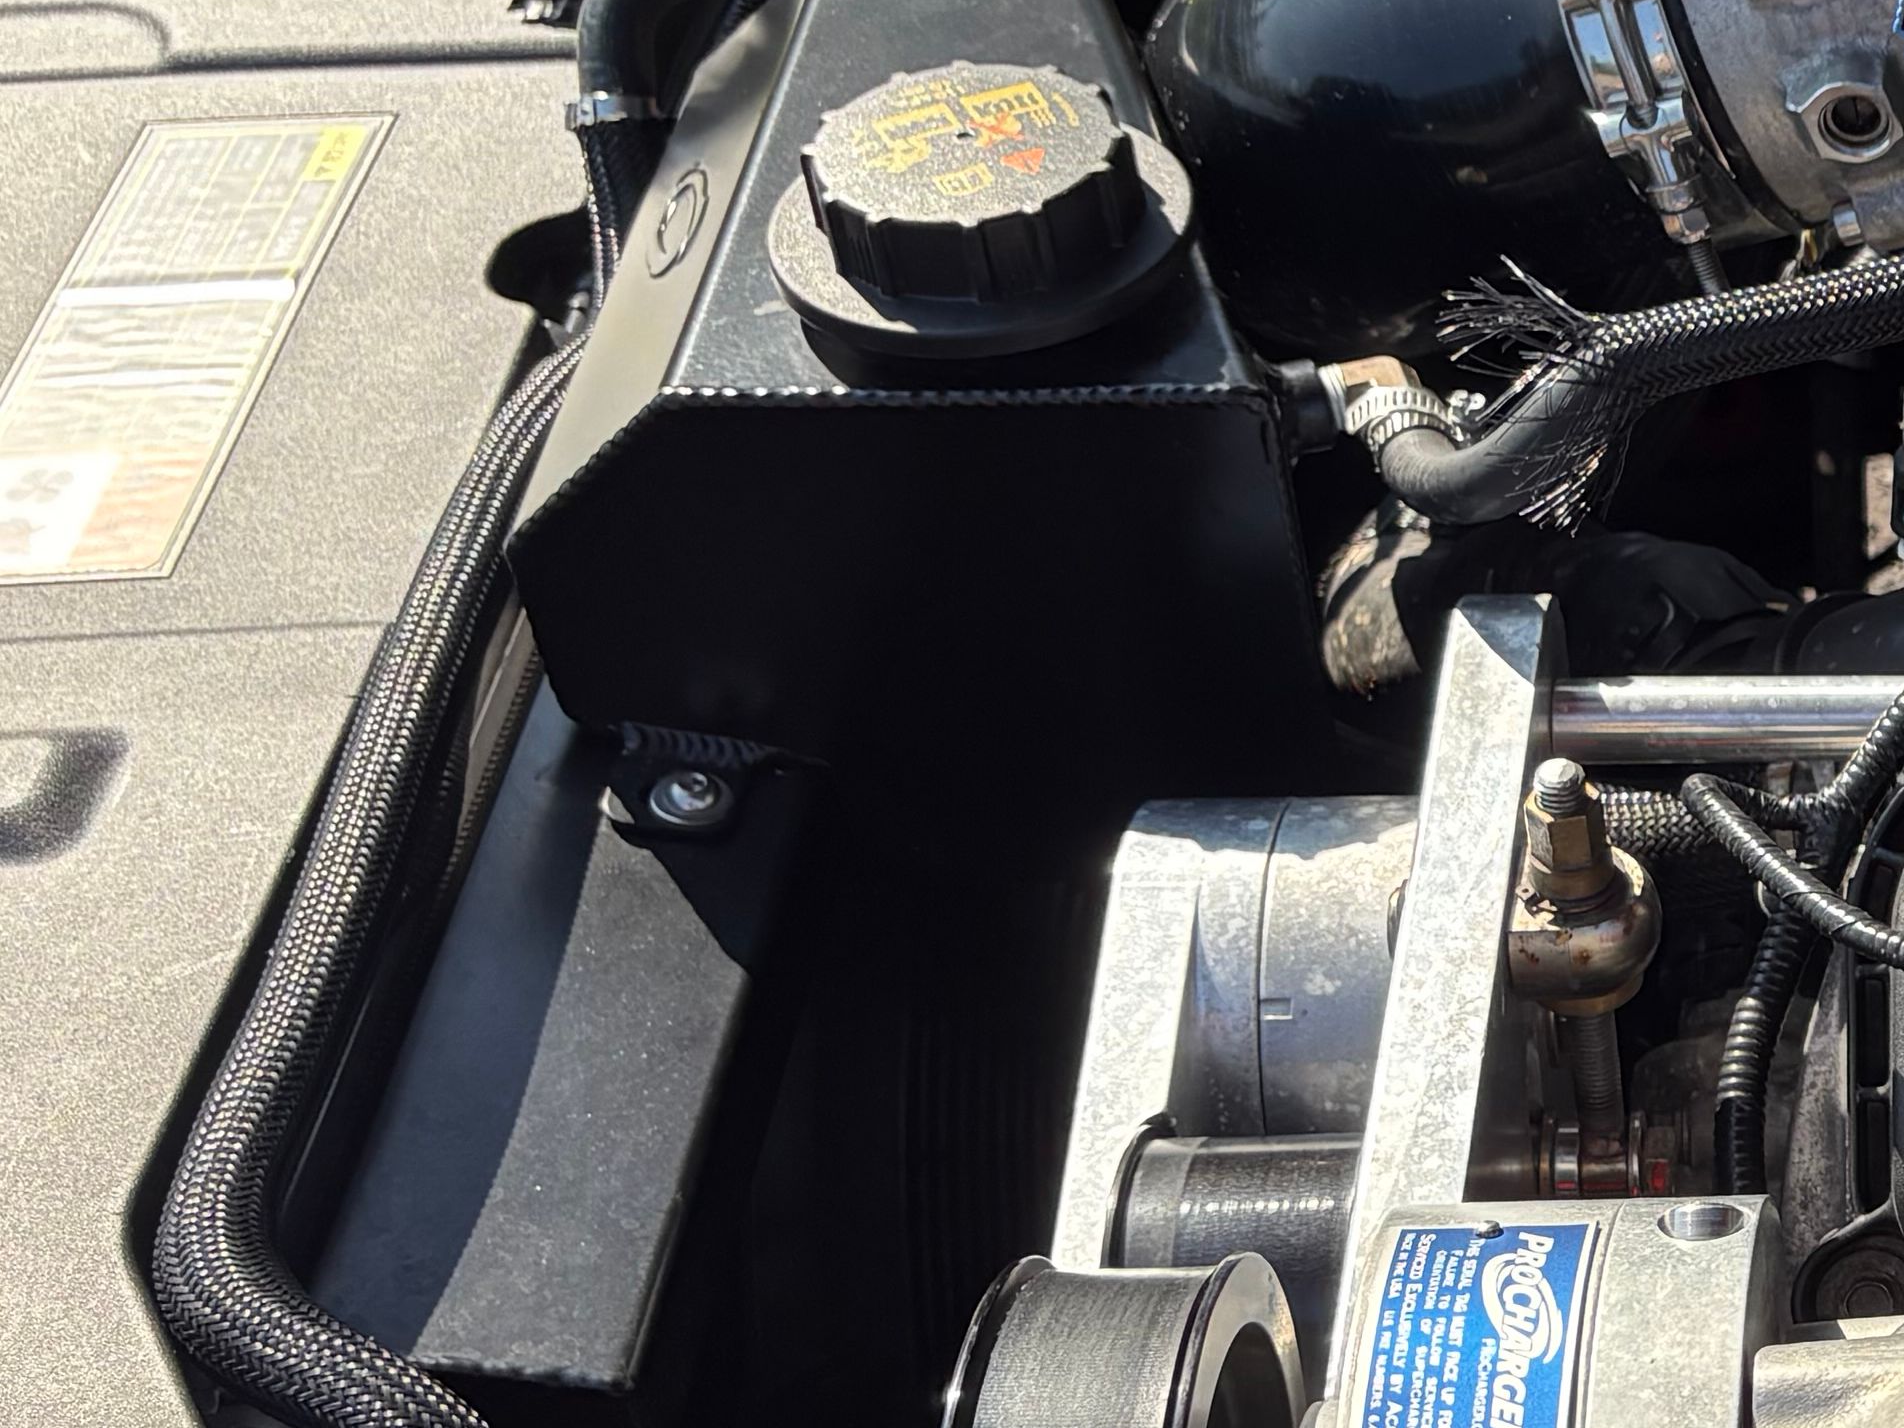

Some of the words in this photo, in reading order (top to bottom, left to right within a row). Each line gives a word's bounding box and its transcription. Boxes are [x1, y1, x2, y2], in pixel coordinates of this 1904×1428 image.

[1437, 1294, 1451, 1310] TO
[1392, 1283, 1423, 1368] EXCLUSIVELY
[1389, 1374, 1404, 1394] BY
[1441, 1387, 1456, 1405] UP
